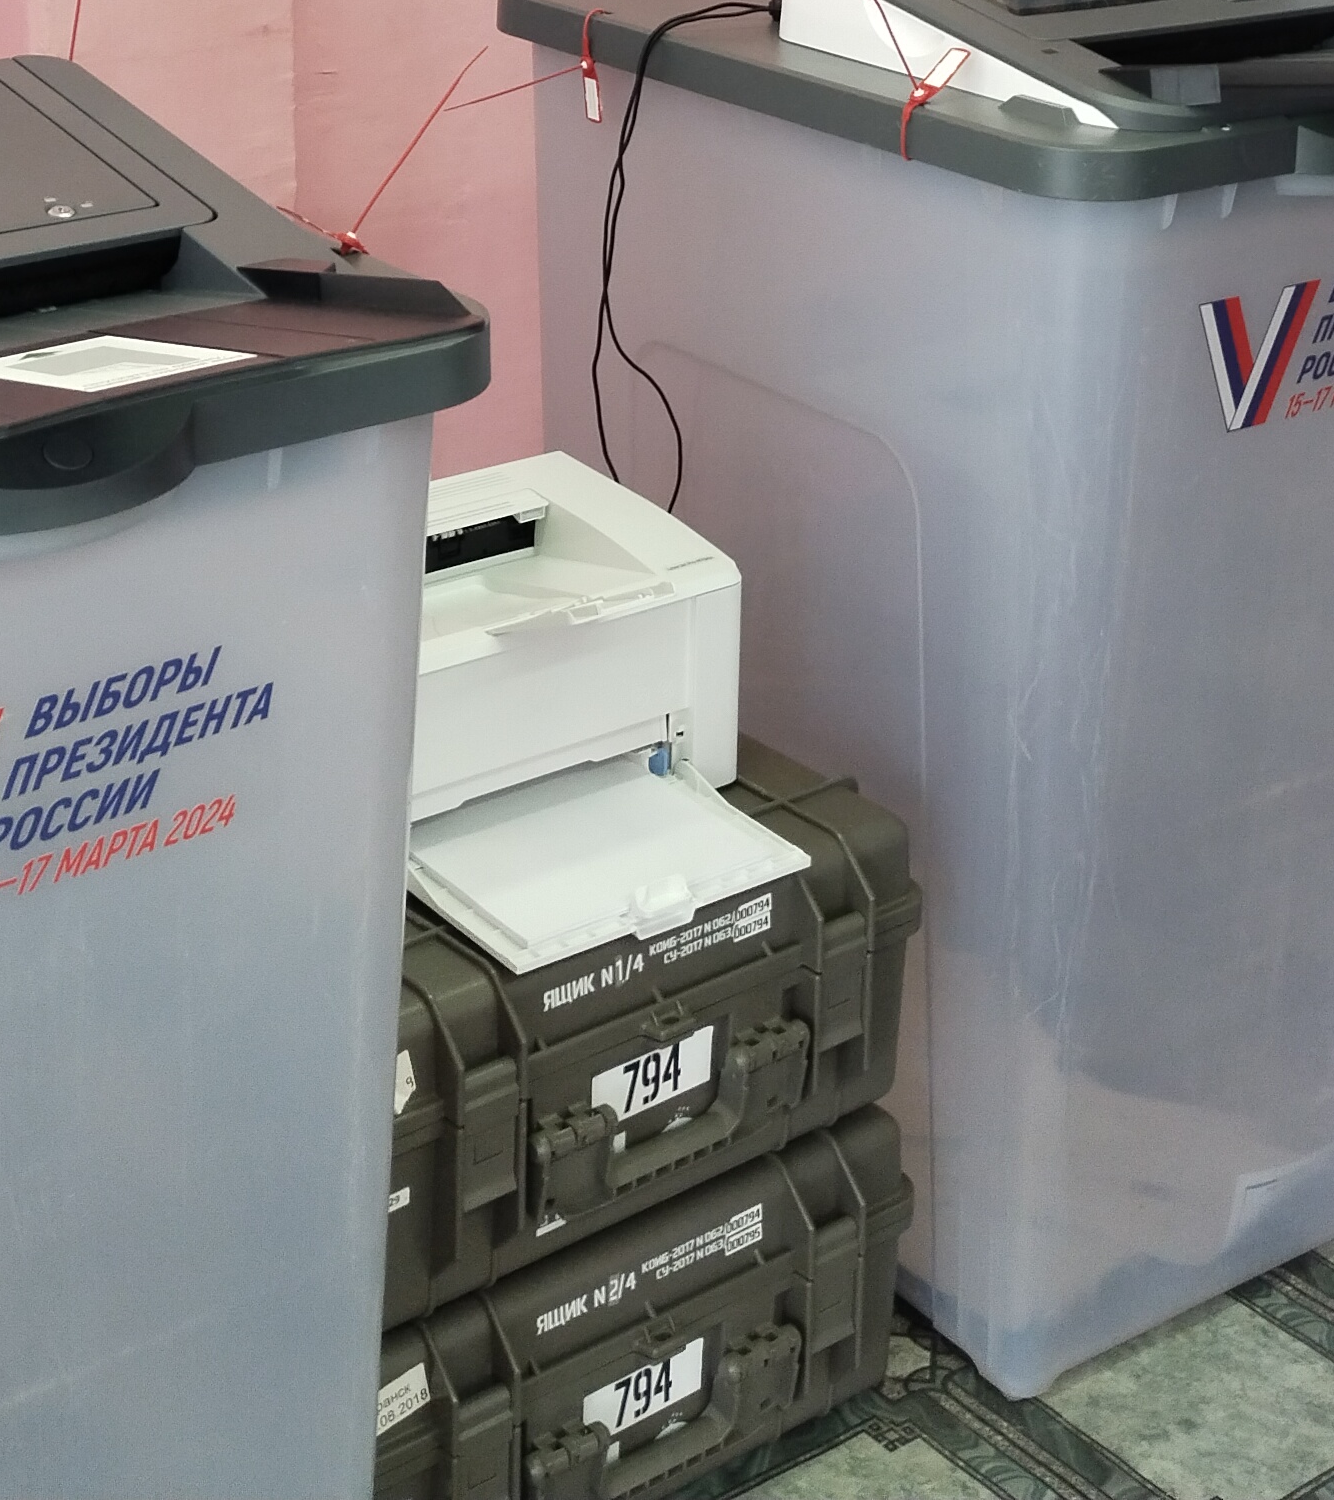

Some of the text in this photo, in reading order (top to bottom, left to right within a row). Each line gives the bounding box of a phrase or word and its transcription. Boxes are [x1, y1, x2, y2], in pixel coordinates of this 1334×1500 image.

[23, 645, 223, 740] ВЫБОРЫ
[1, 681, 275, 801] ПРЕЗИДЕНТА
[53, 825, 158, 885] МАРТА
[163, 793, 237, 847] 2024
[663, 938, 704, 964] СУ-2017
[543, 973, 595, 1012] ЯЩИК
[622, 1041, 682, 1113] 794
[536, 1293, 588, 1336] ЯЩИК
[614, 1358, 673, 1428] 794
